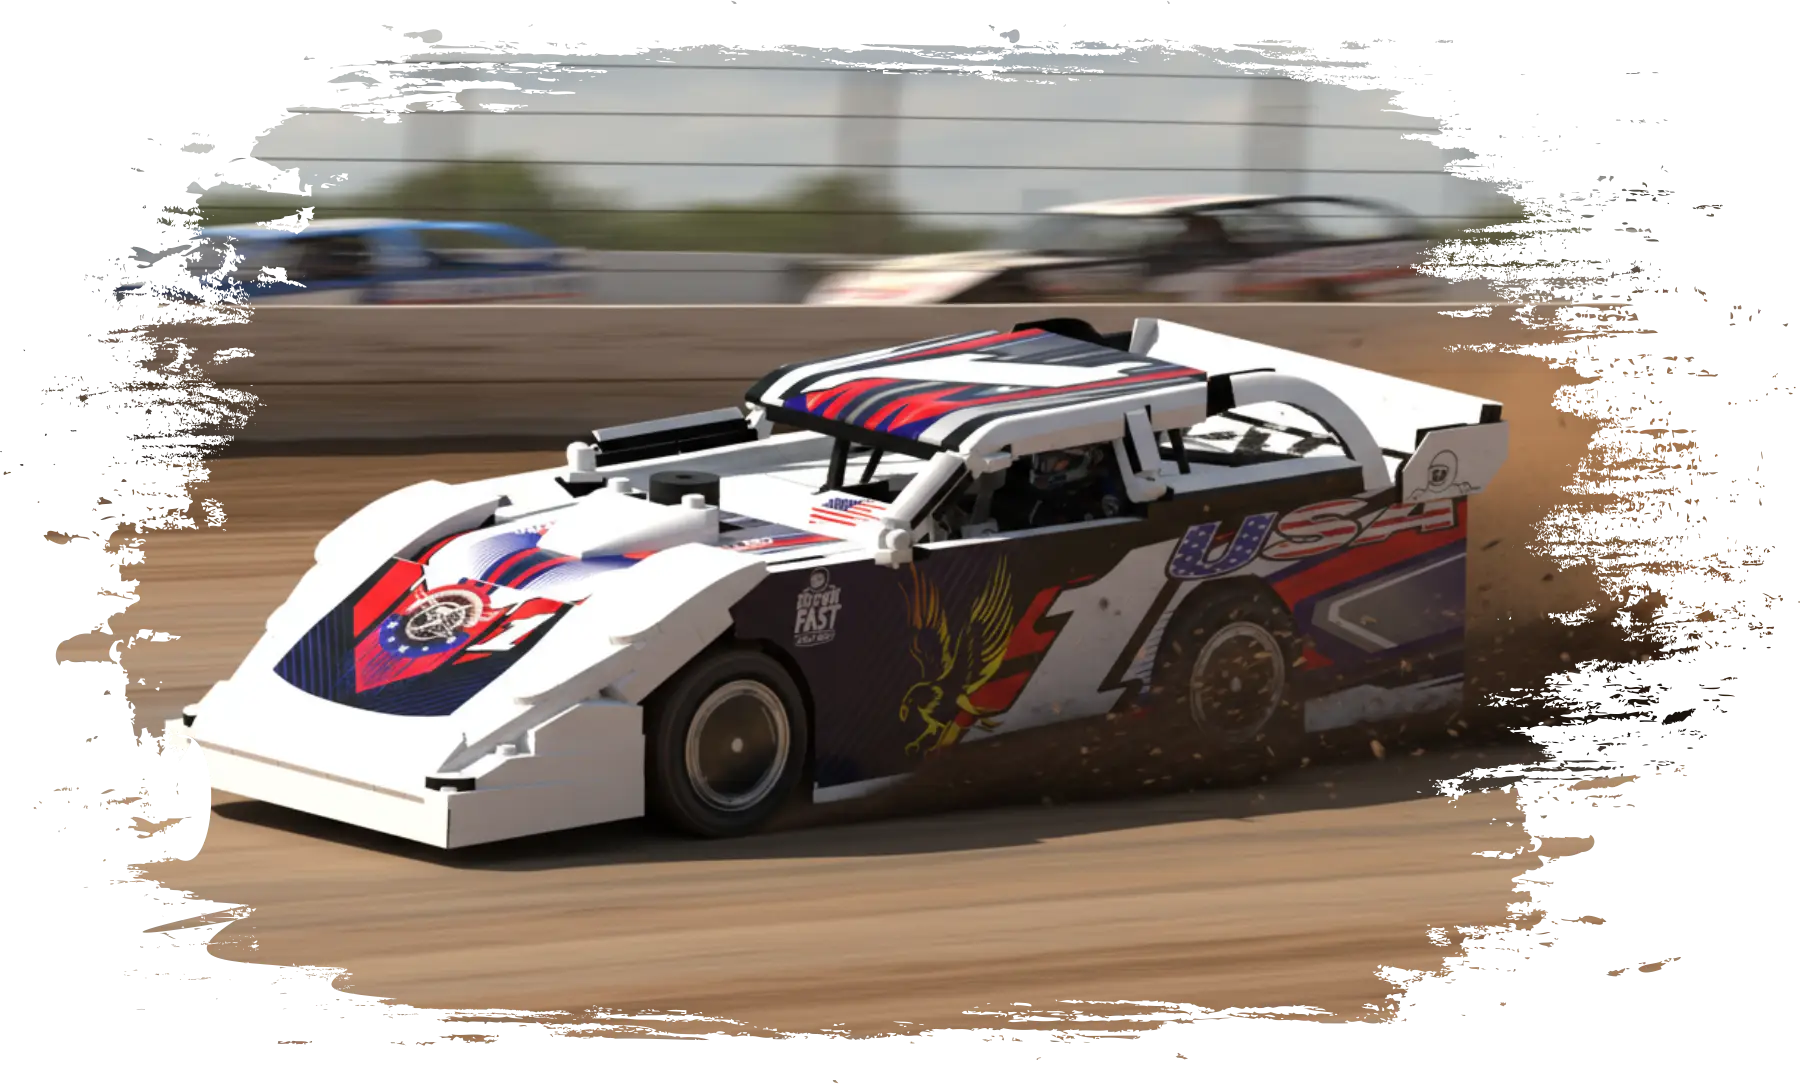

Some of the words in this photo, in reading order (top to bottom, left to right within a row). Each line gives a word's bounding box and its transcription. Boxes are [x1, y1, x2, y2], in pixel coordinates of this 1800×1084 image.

[1165, 497, 1459, 580] USA
[793, 604, 843, 634] FAST
[959, 539, 1180, 743] 1
